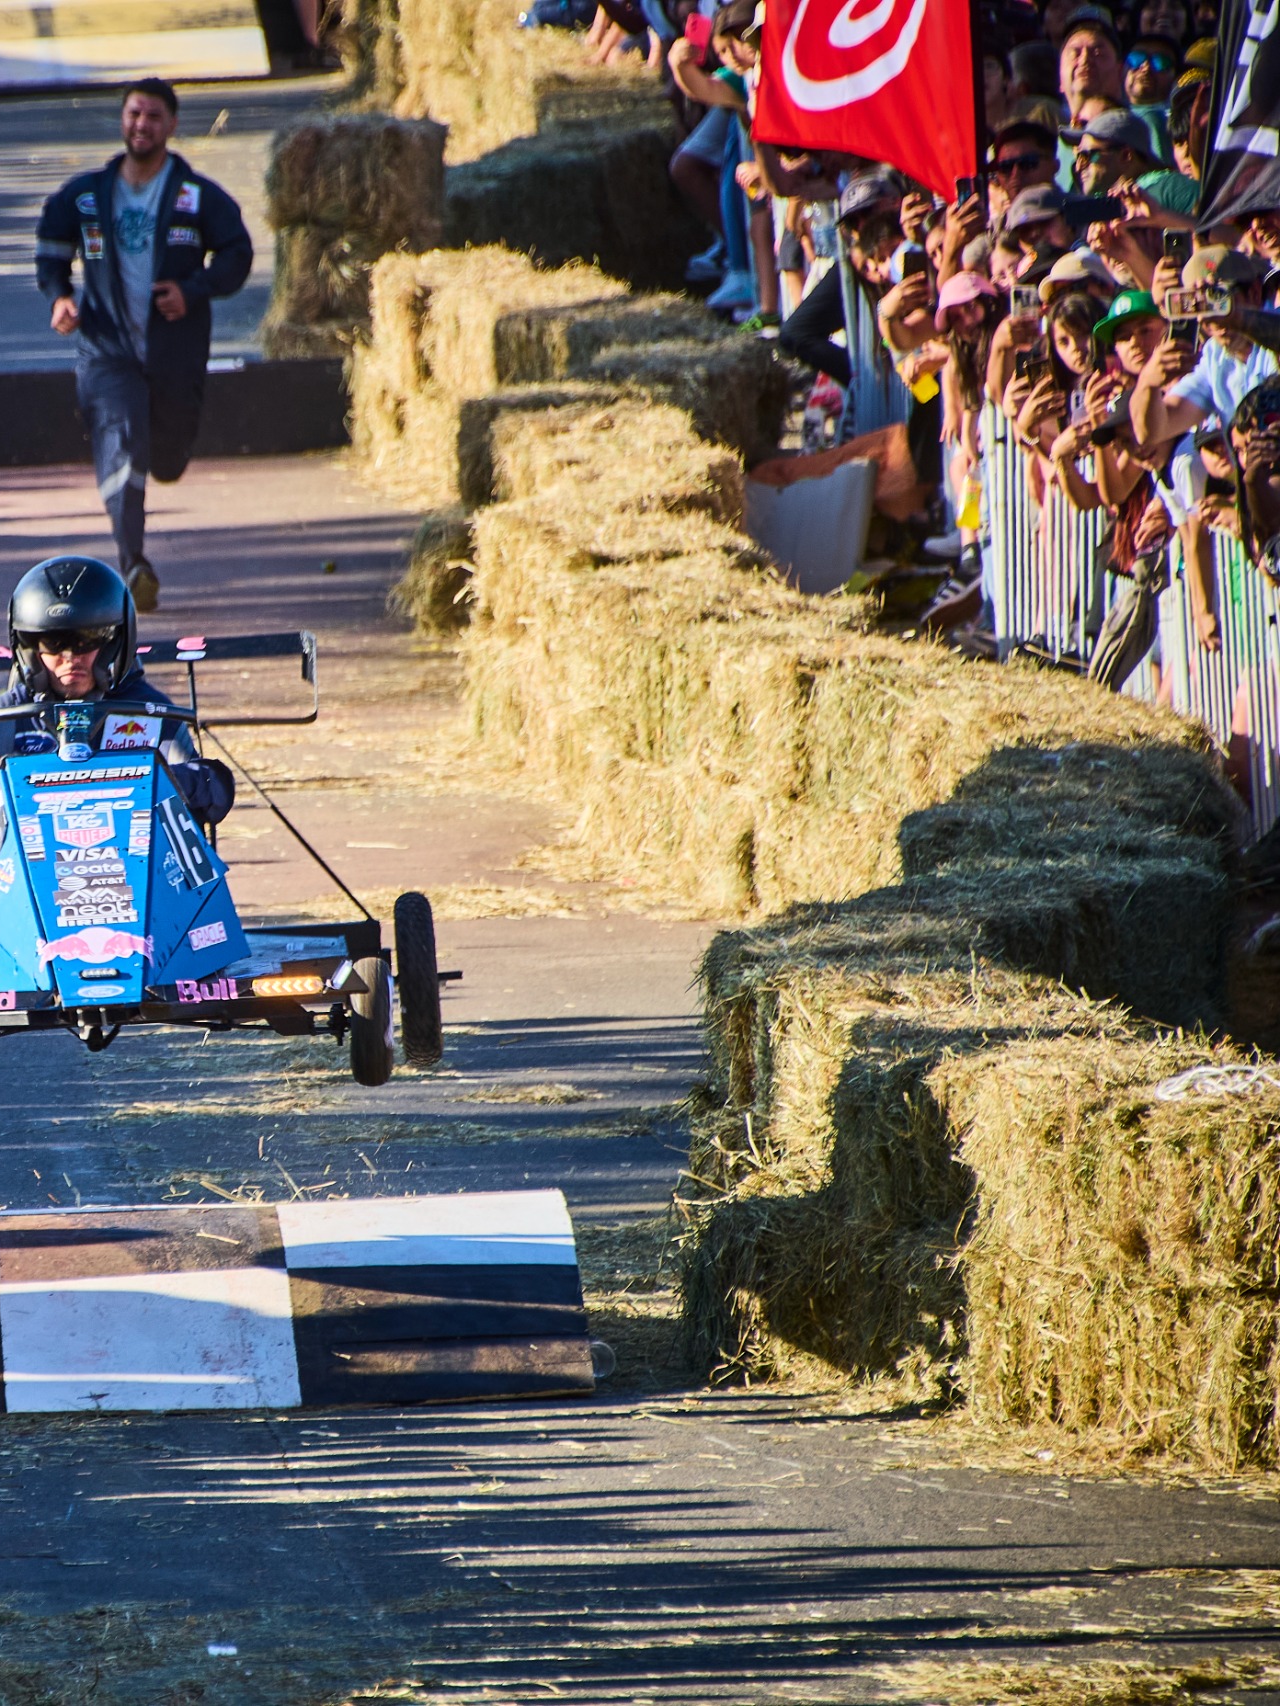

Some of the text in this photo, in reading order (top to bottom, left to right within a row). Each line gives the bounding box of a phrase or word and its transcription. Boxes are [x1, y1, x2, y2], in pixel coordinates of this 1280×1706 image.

[28, 765, 152, 784] PRODESAR
[63, 813, 104, 830] TAG
[59, 829, 111, 848] HEUER
[55, 847, 118, 862] VISA
[90, 877, 125, 886] AT&T
[190, 922, 226, 949] ORACLE
[175, 978, 238, 1004] Bull
